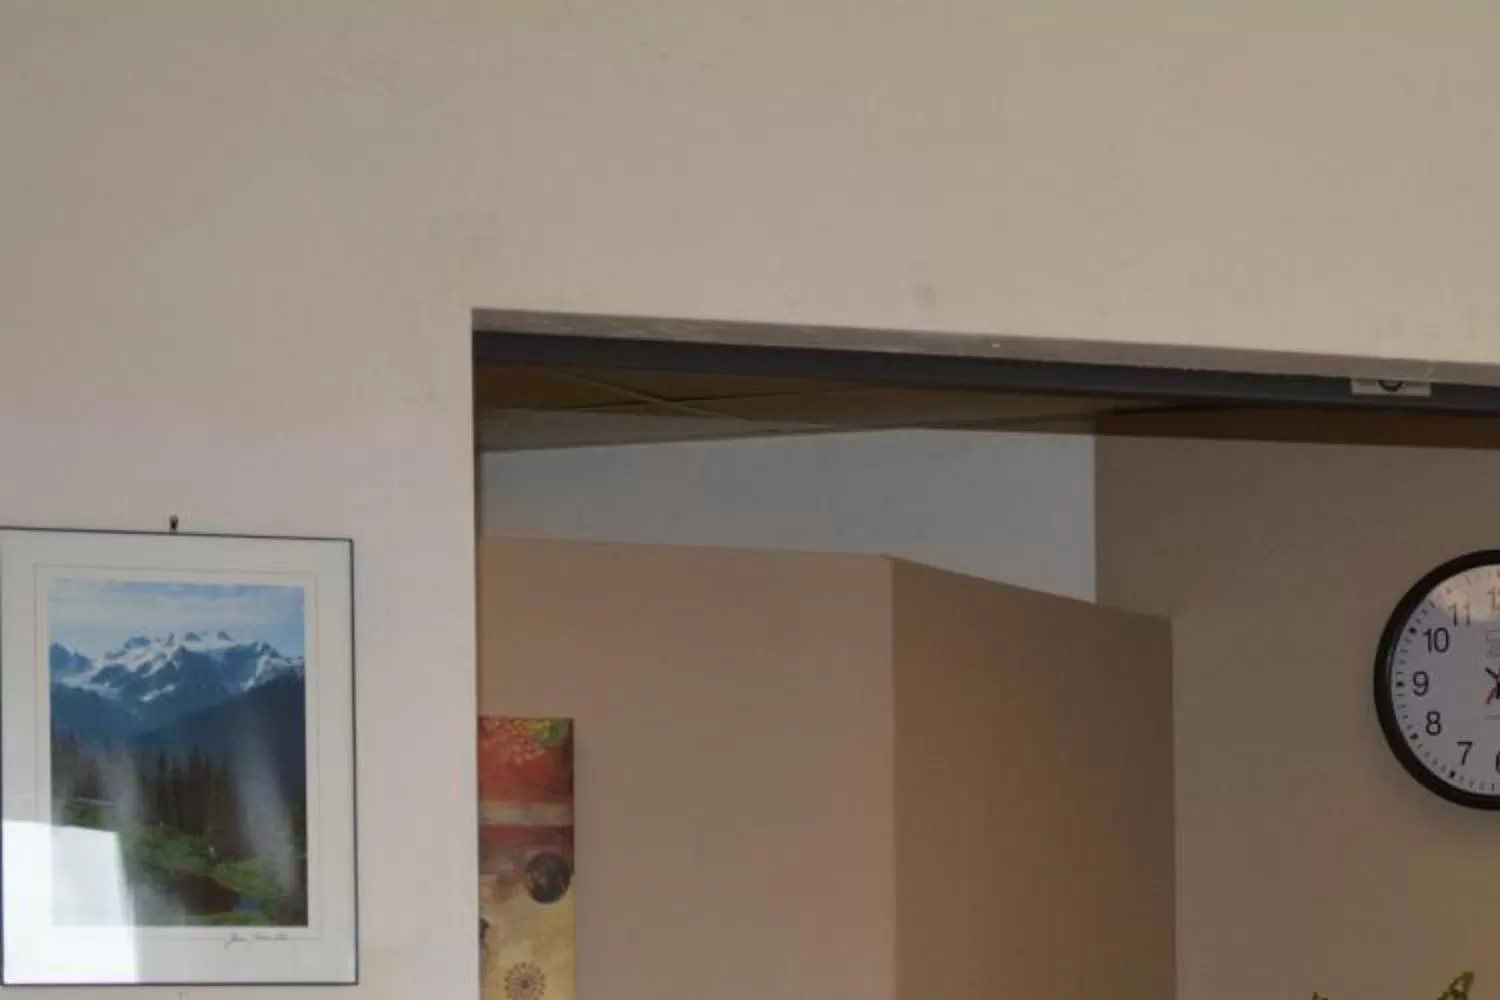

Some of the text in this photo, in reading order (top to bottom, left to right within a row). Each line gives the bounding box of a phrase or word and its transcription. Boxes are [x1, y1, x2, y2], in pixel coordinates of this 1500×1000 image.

[1450, 602, 1472, 627] 11
[1423, 627, 1450, 653] 10
[1412, 671, 1429, 696] 9
[1425, 711, 1442, 736] 8
[1456, 741, 1473, 766] 7
